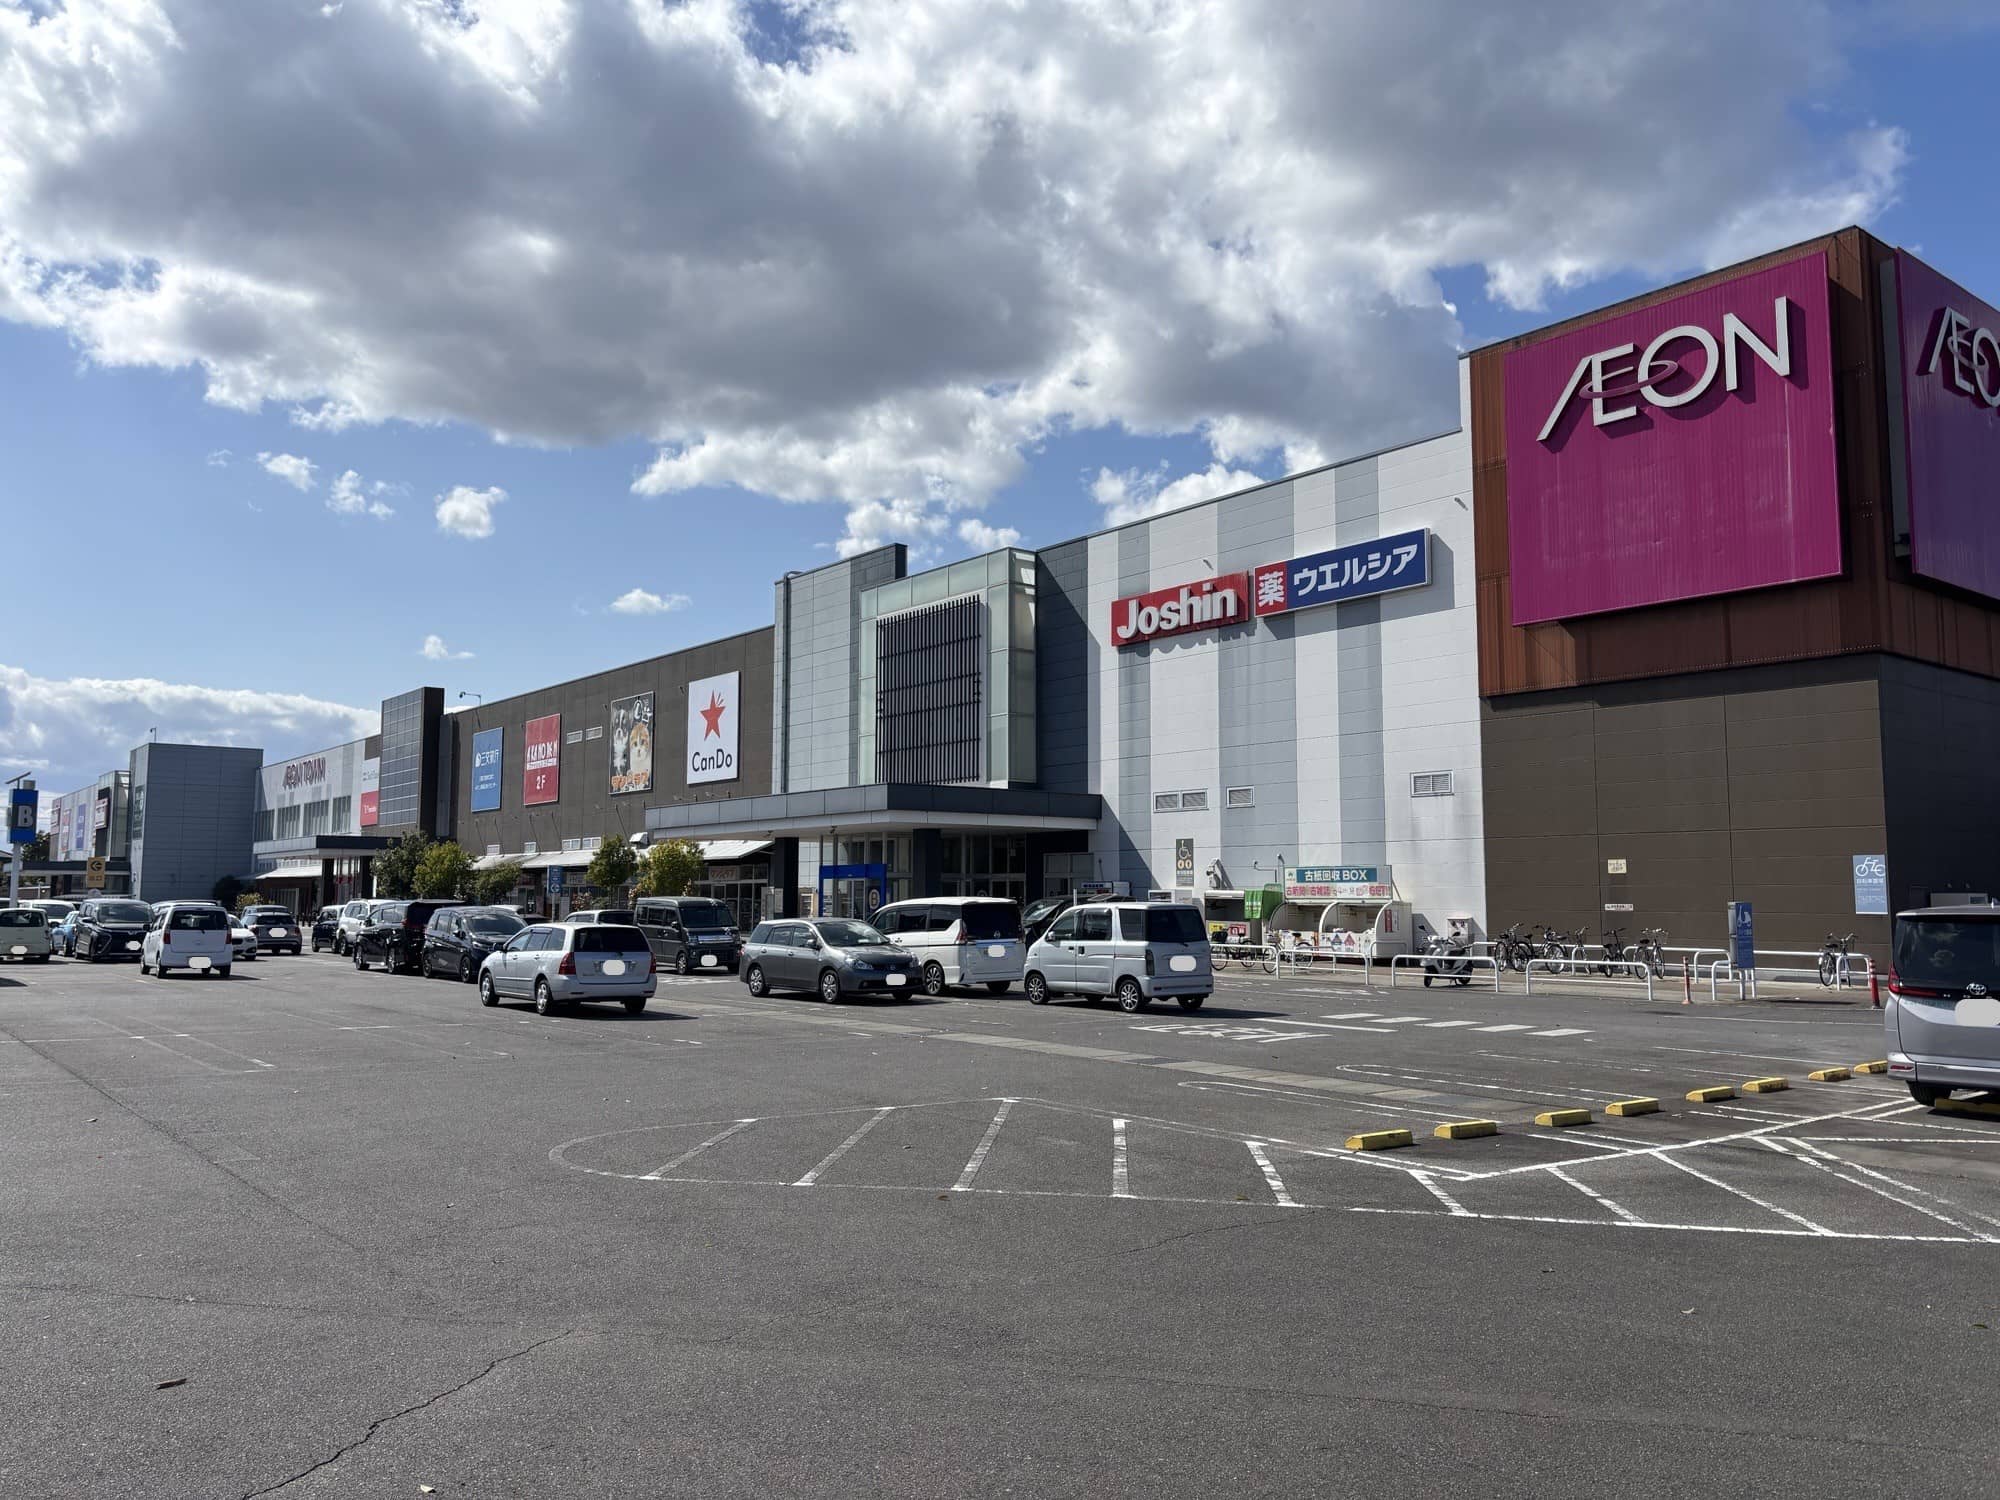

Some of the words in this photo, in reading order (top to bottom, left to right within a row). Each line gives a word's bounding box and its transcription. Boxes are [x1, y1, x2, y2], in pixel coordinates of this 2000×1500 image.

[1258, 571, 1285, 607] 薬
[1293, 544, 1417, 596] ウエルシア
[1116, 582, 1237, 639] Joshin
[691, 748, 732, 772] CanDo
[536, 774, 546, 790] 2F
[17, 805, 33, 828] B
[1304, 870, 1340, 882] 古紙回収
[1342, 869, 1367, 881] BOX
